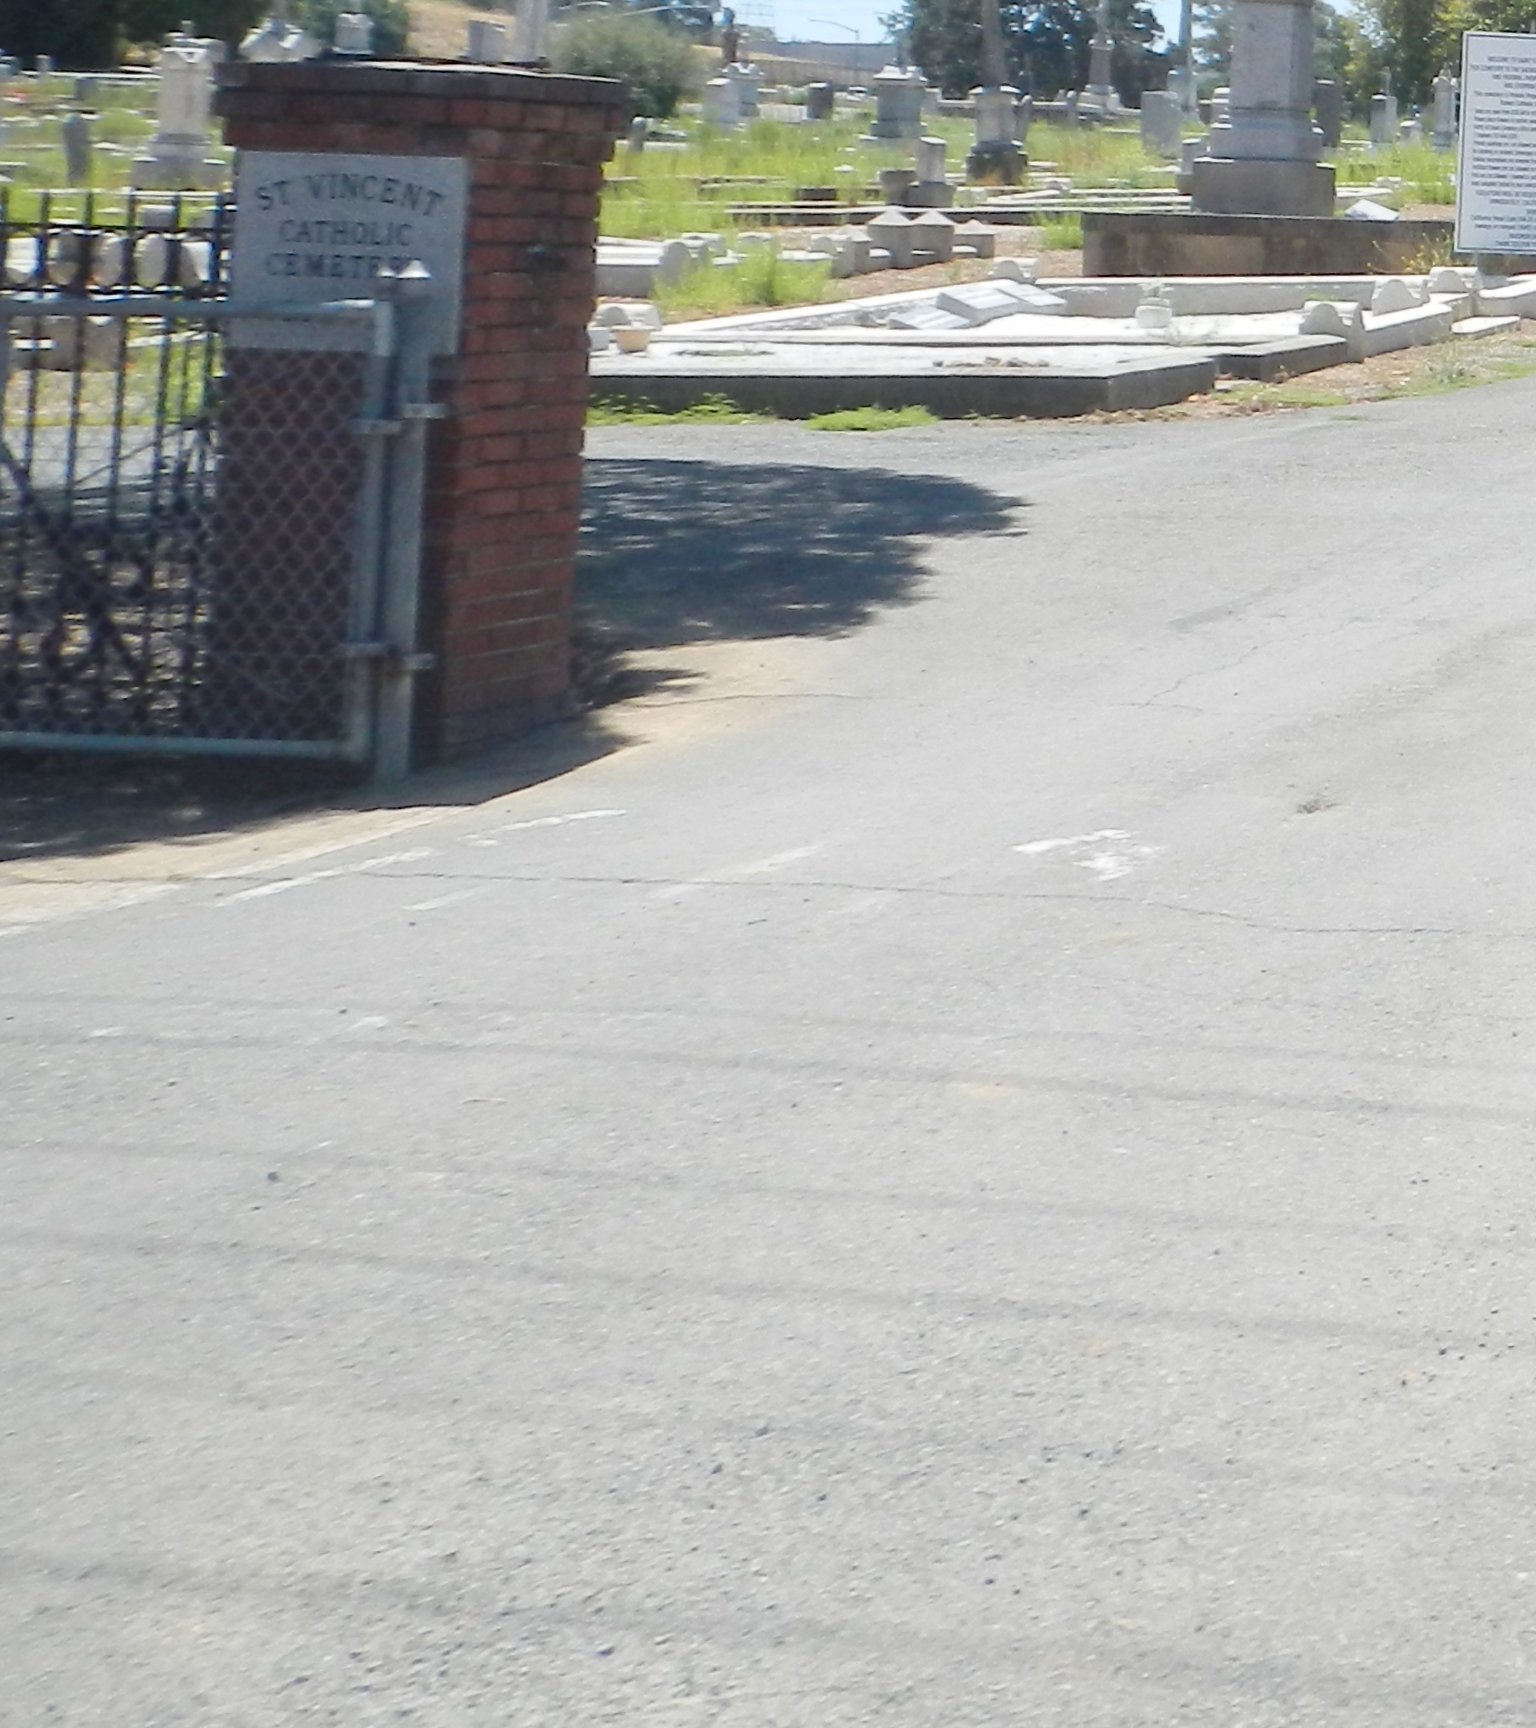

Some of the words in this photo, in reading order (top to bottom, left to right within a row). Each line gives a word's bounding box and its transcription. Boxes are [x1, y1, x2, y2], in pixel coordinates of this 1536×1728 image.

[306, 173, 444, 216] VINCENT
[279, 220, 413, 247] CATHOLIC
[265, 253, 421, 278] CEMETER
